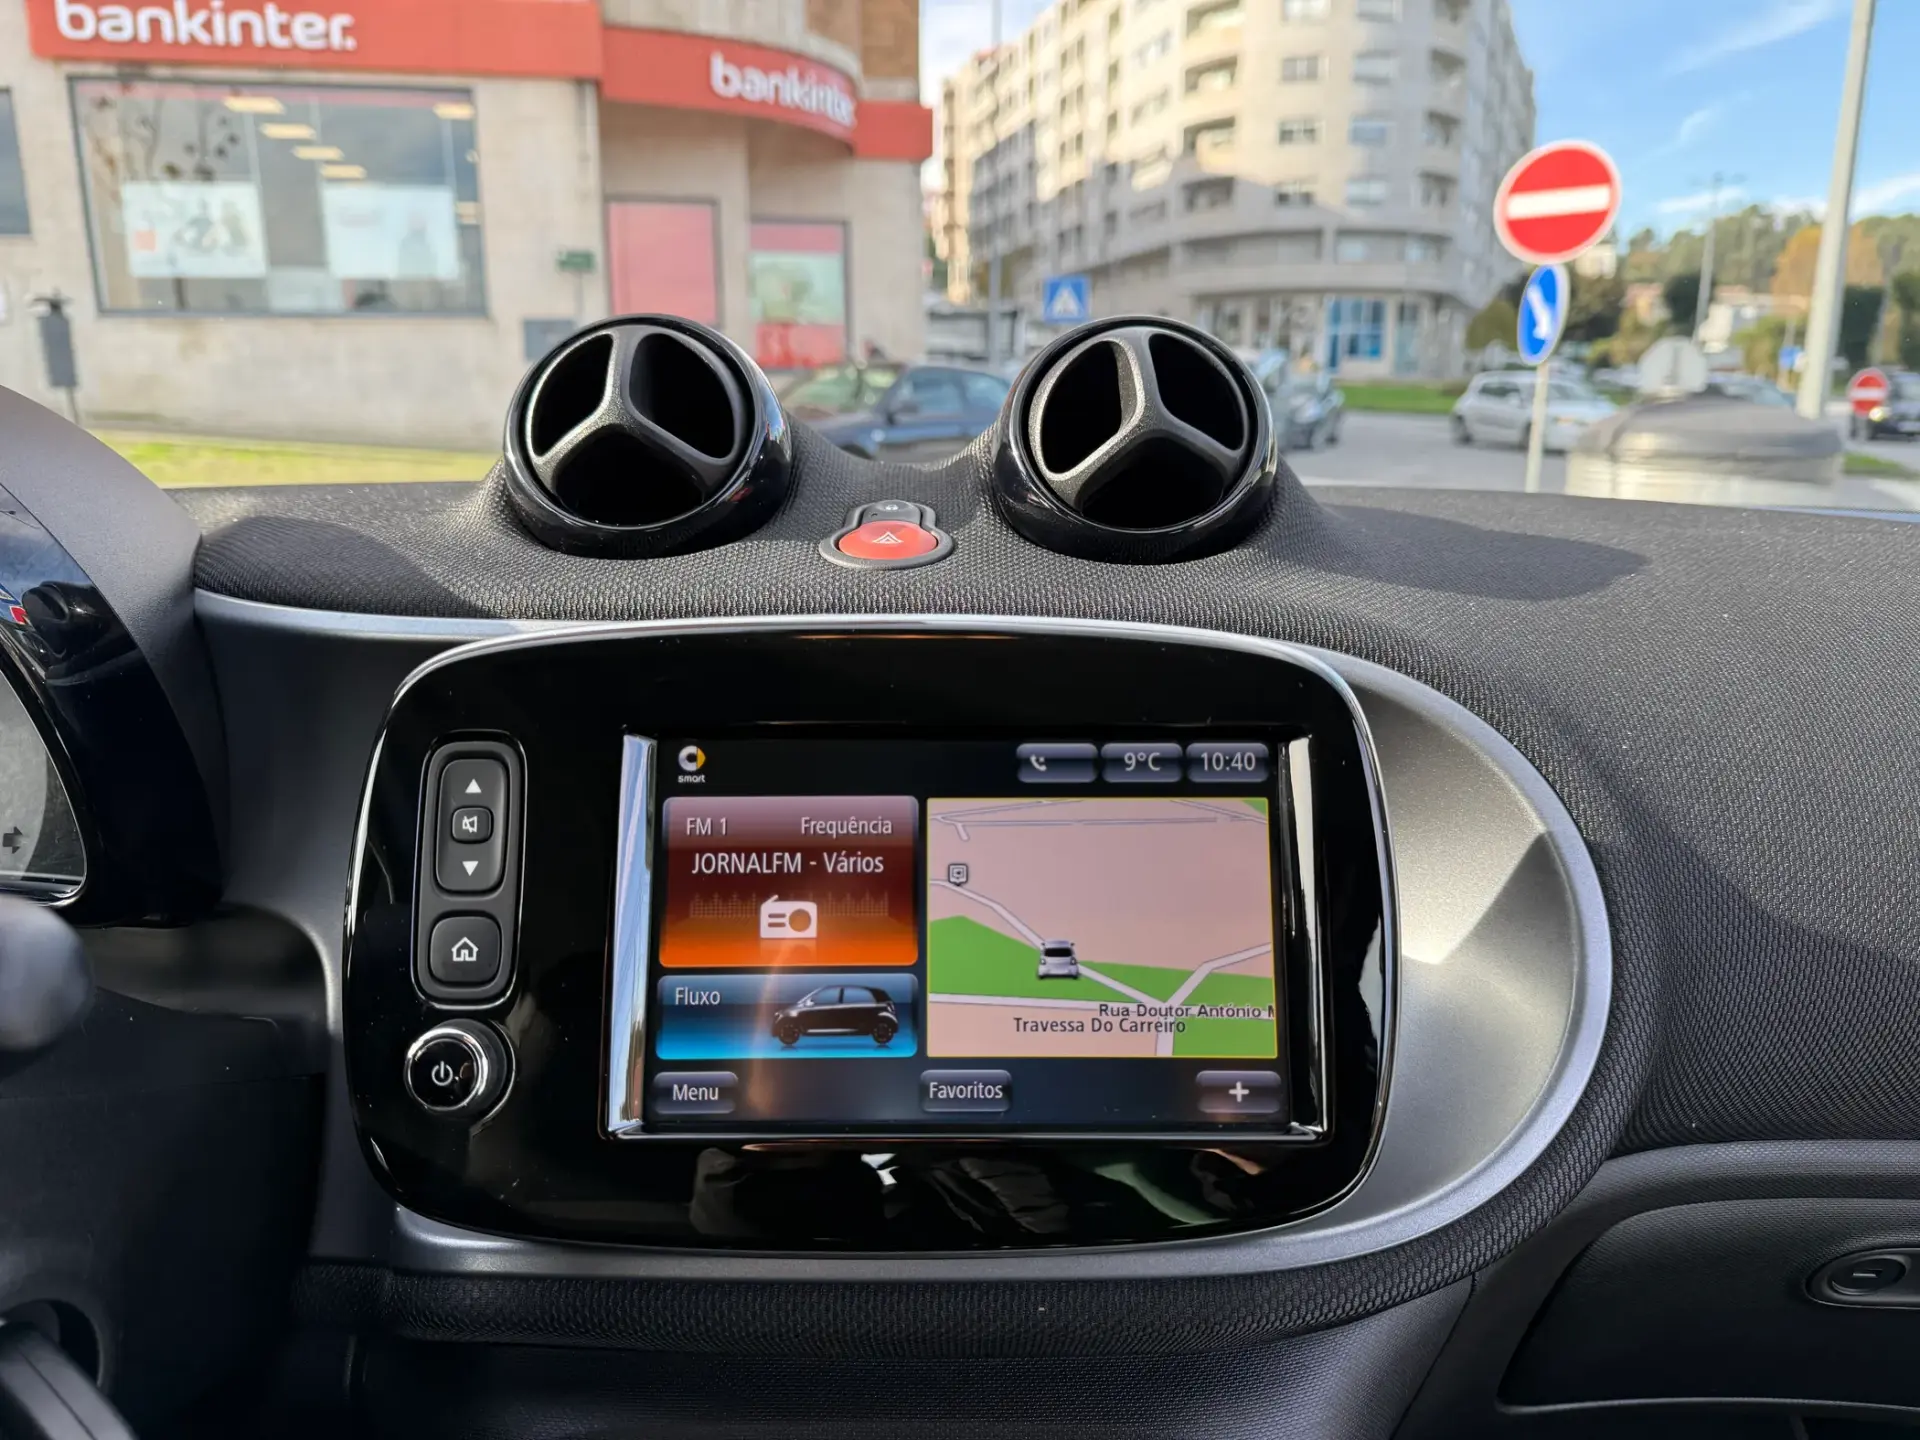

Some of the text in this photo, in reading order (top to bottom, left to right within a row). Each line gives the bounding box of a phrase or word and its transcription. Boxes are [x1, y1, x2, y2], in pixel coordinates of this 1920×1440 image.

[1124, 751, 1161, 772] 9°C
[1201, 751, 1256, 771] 10:40
[678, 774, 706, 783] smart
[686, 817, 728, 835] FM 1
[800, 816, 892, 839] Frequência
[692, 852, 801, 874] JORNALFM
[823, 850, 884, 873] Vários
[674, 987, 721, 1005] Fluxo
[1099, 1003, 1129, 1017] Rua
[1136, 1003, 1190, 1017] Doutor
[1197, 1003, 1261, 1018] António
[1014, 1017, 1186, 1033] Travessa Do Carreiro
[672, 1084, 719, 1101] Menu
[929, 1081, 1003, 1099] Favoritos
